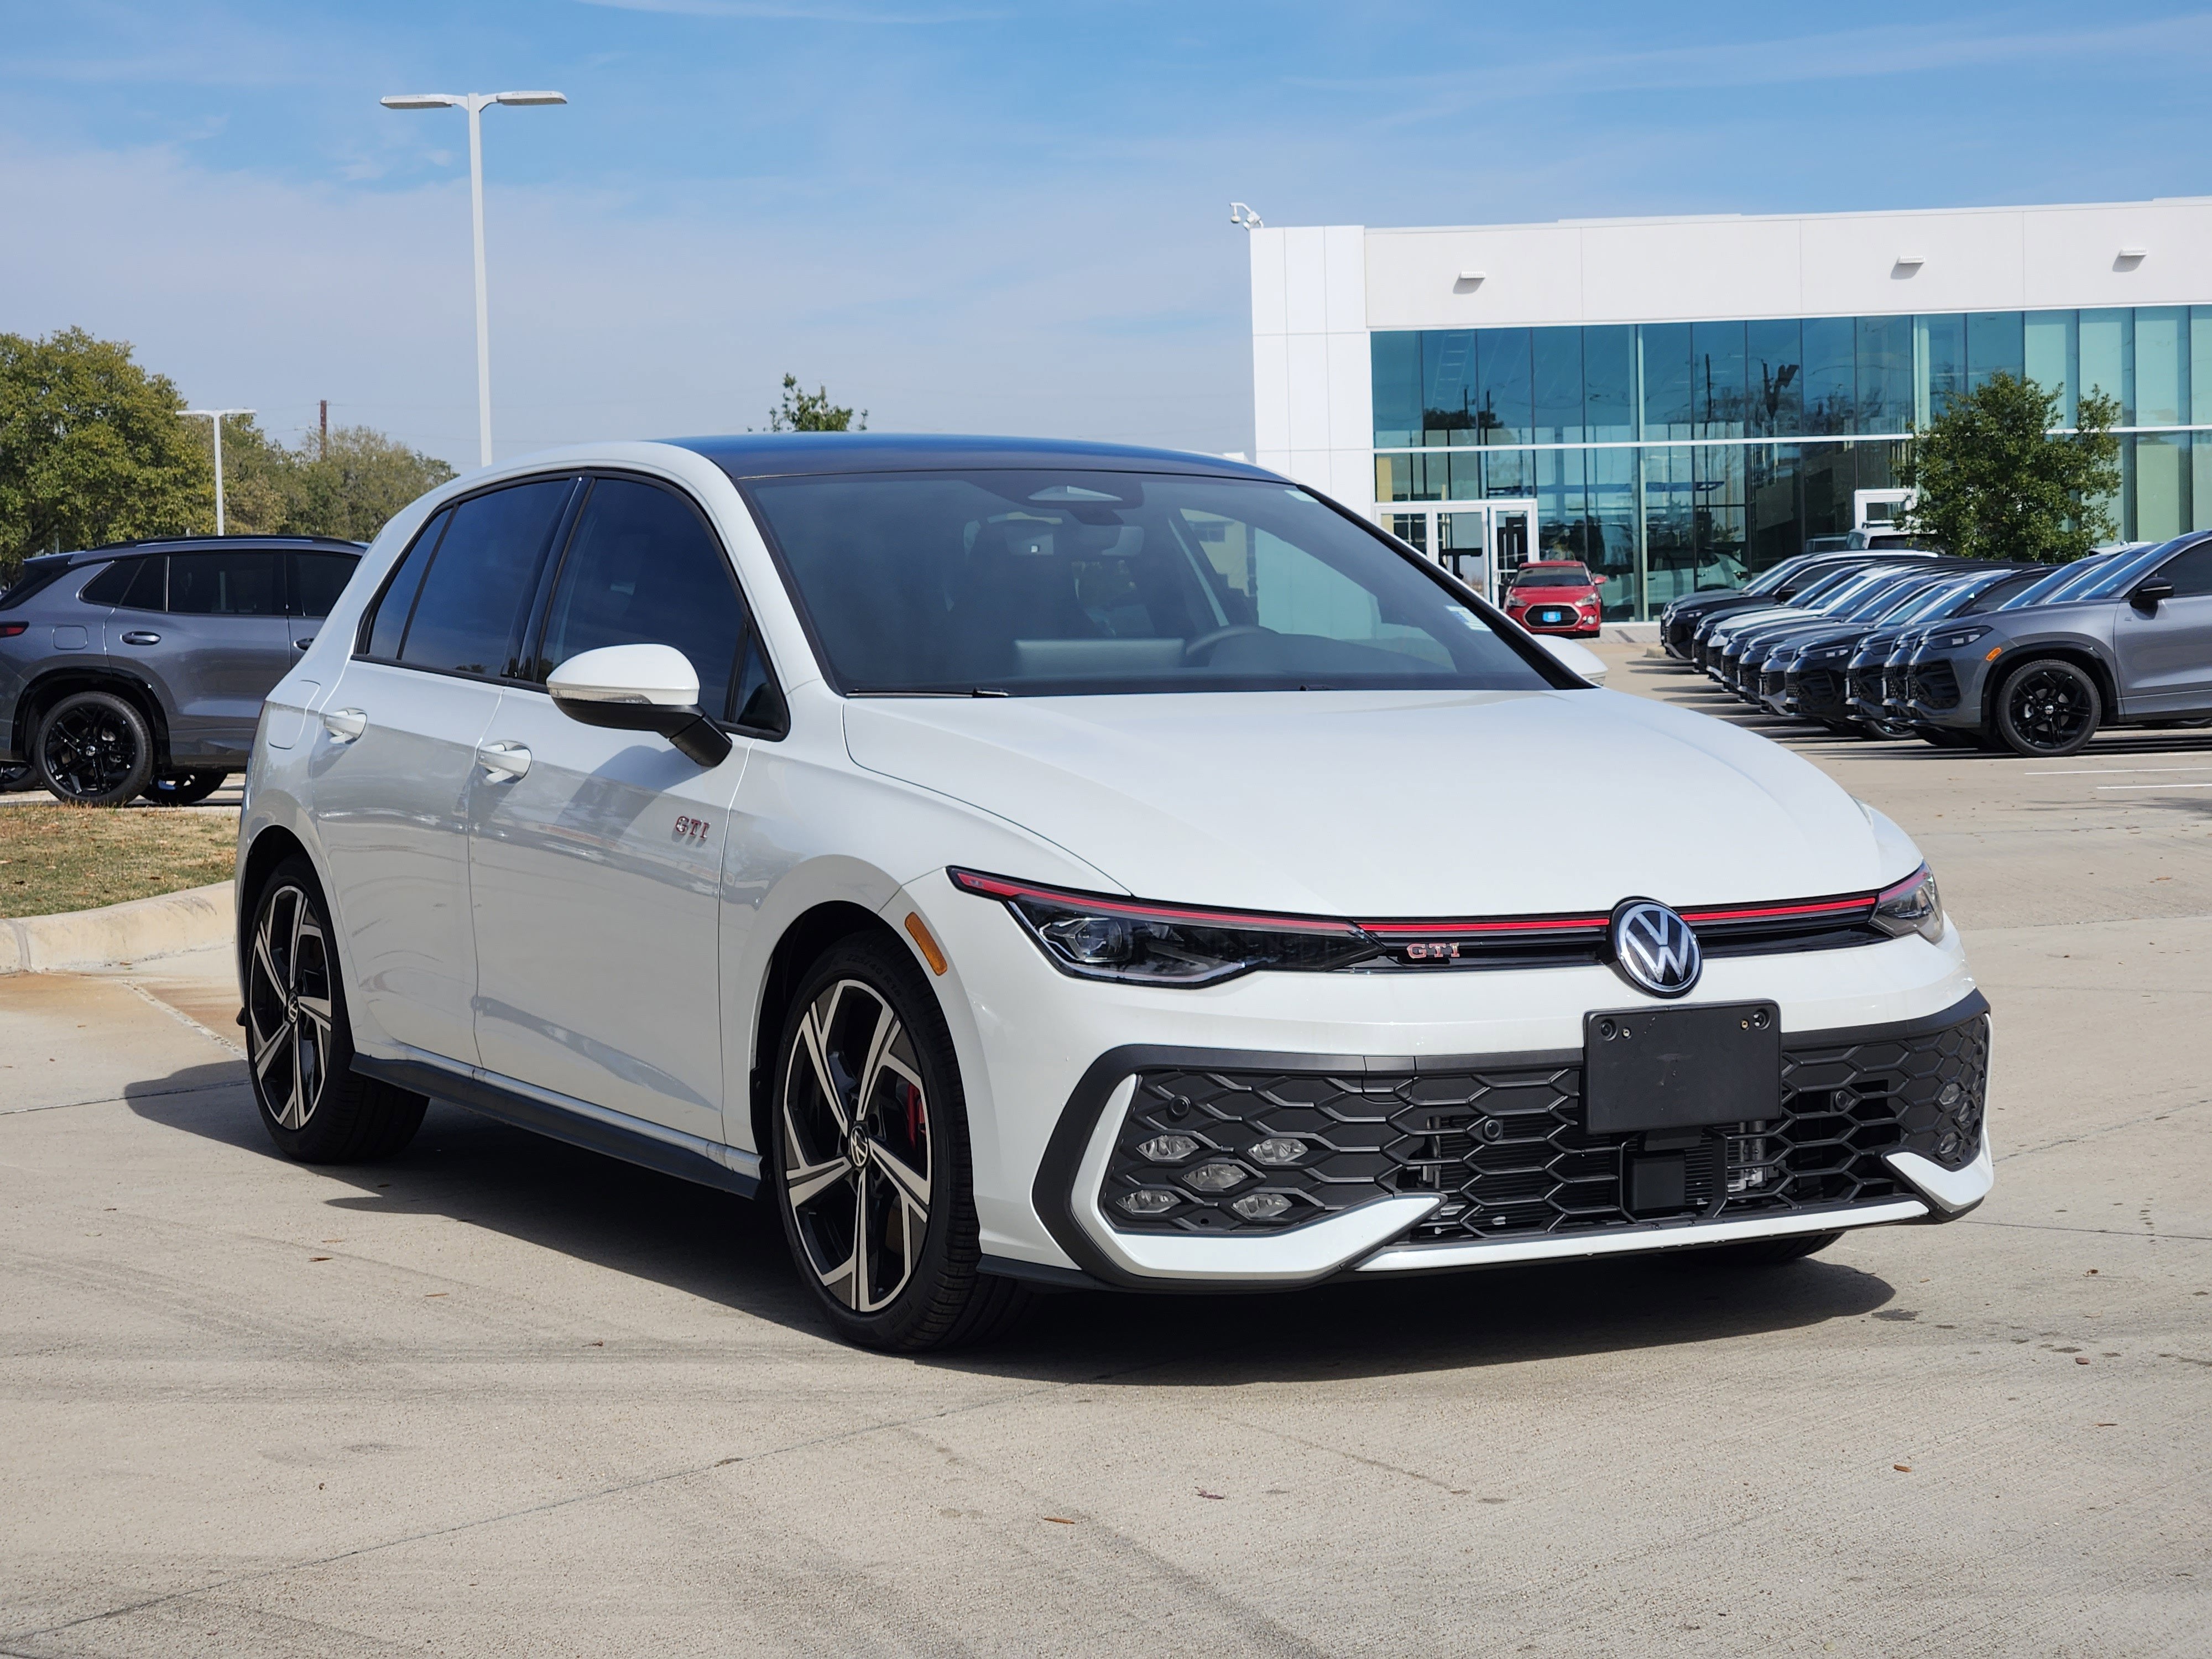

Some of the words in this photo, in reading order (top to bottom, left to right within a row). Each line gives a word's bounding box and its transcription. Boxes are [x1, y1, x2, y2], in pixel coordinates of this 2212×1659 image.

[675, 816, 711, 838] GTI
[1407, 942, 1459, 959] GTI
[1623, 907, 1693, 987] VW
